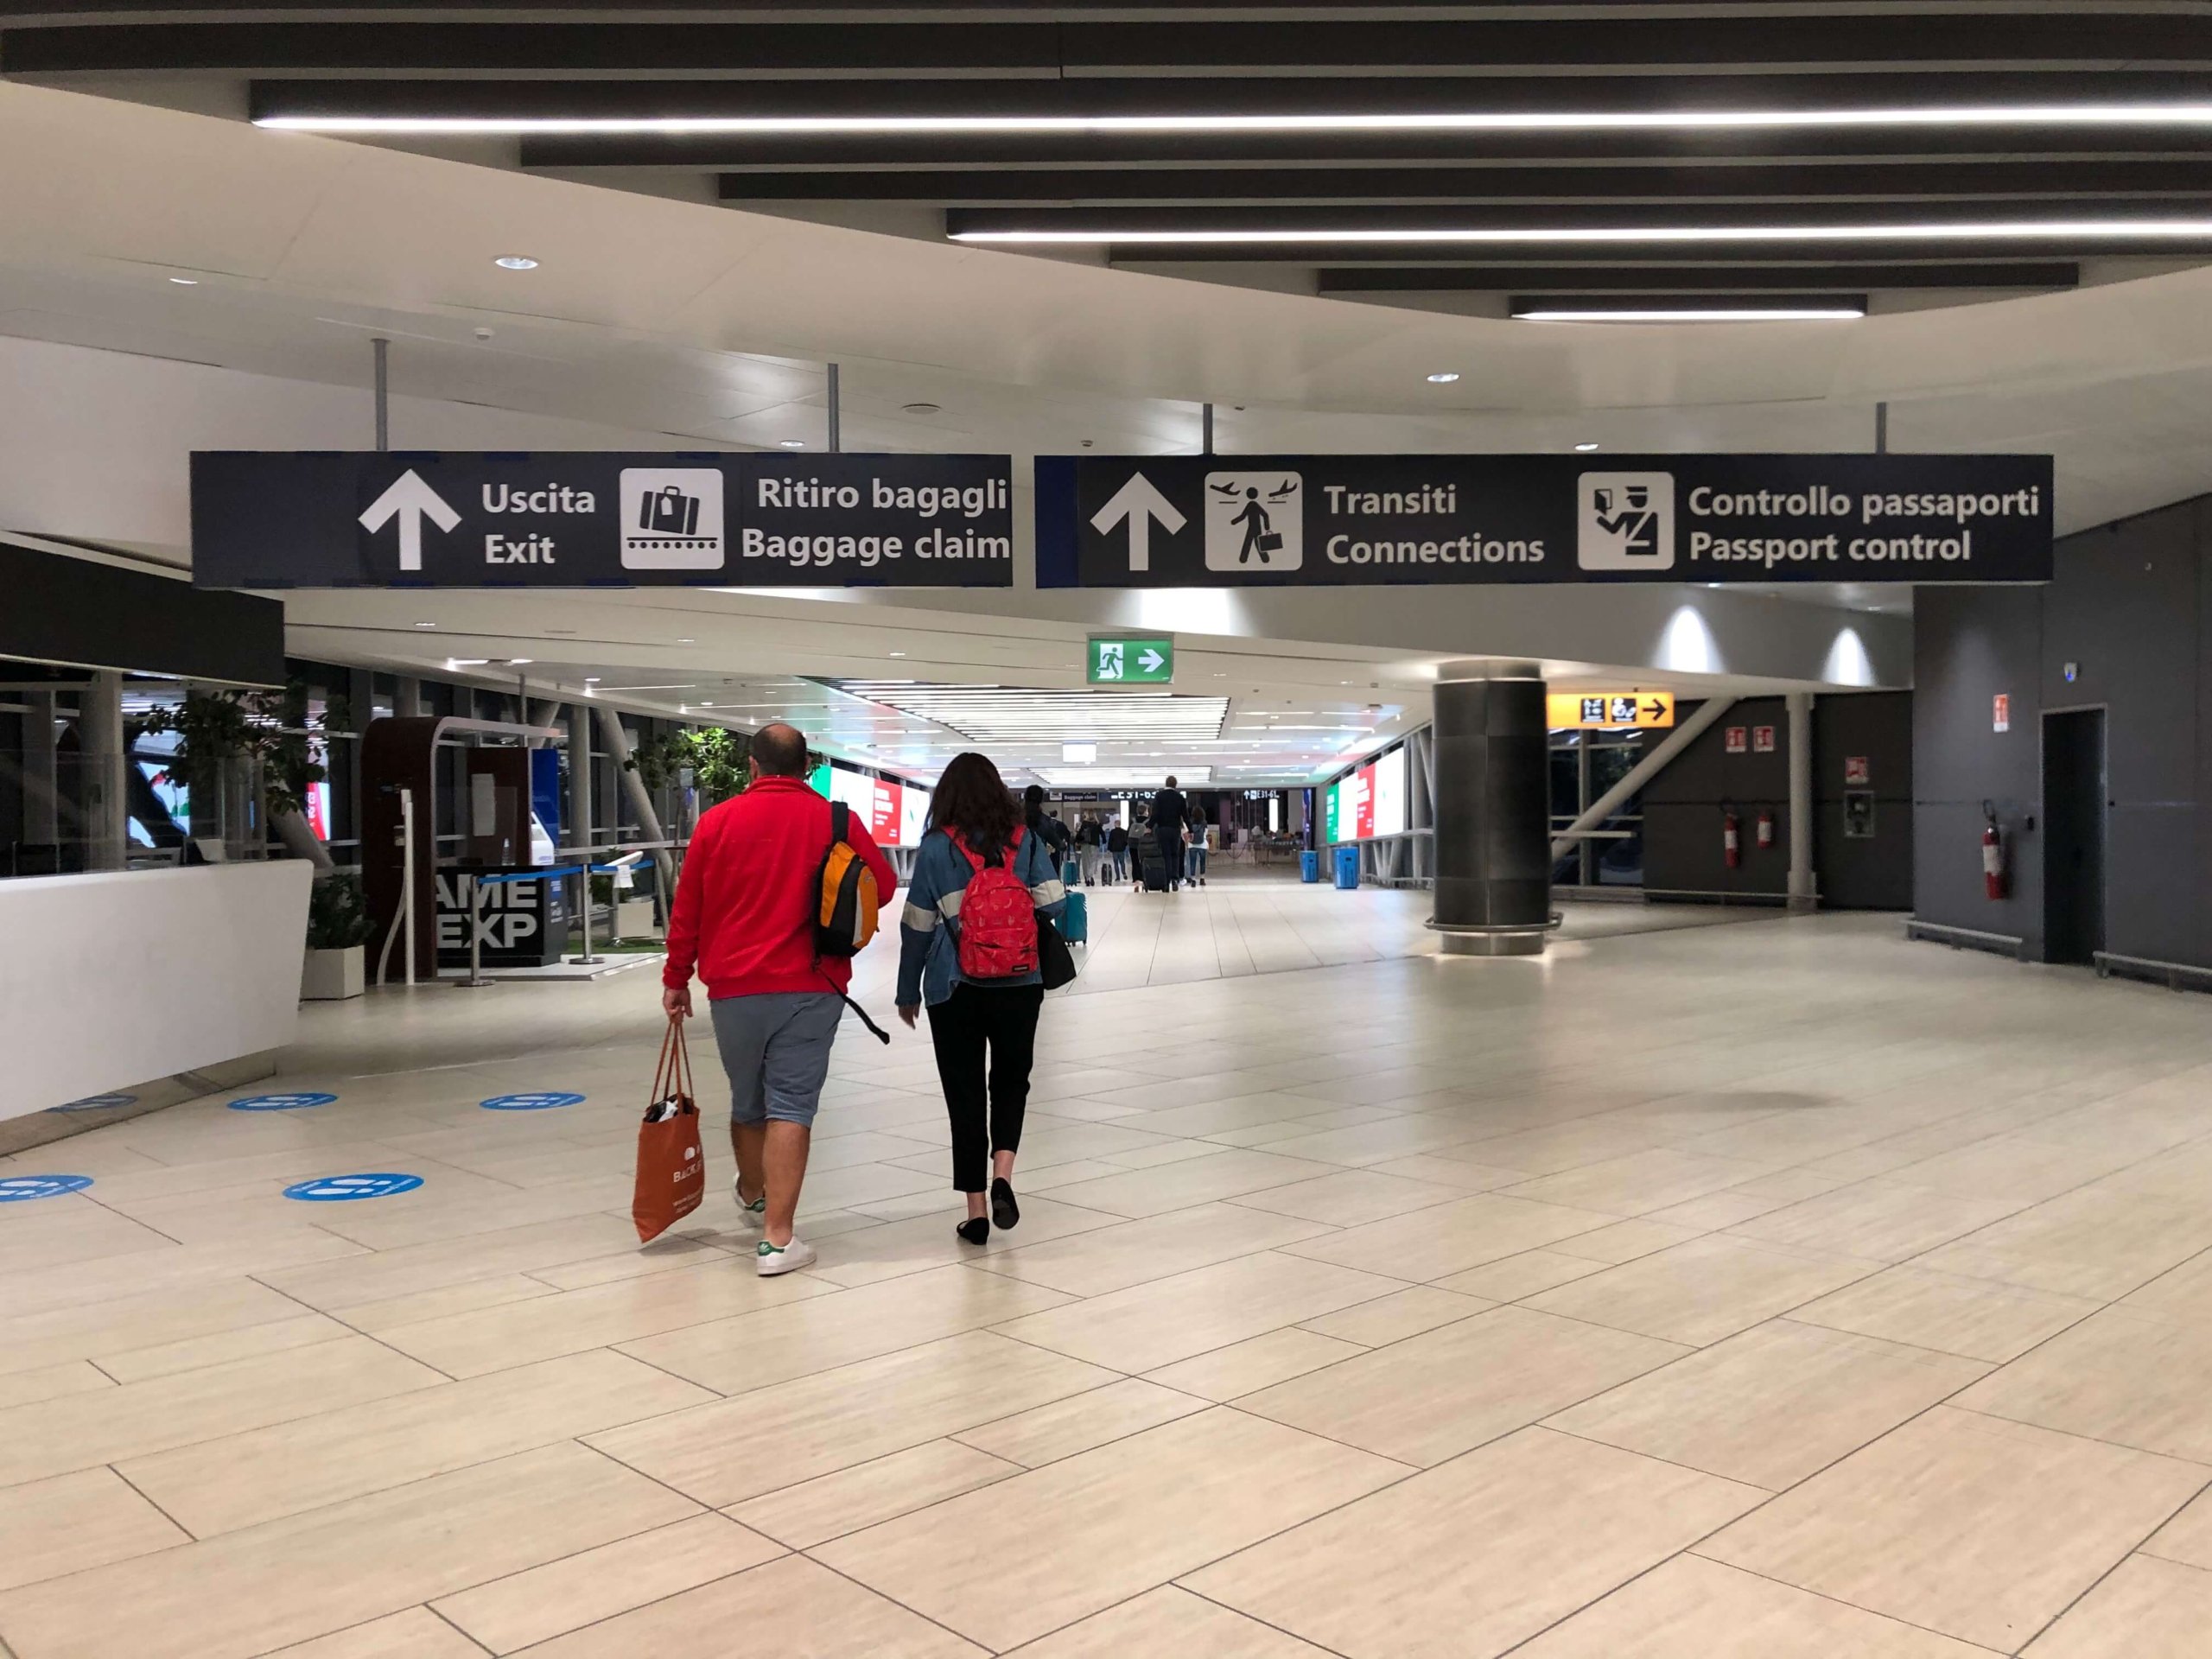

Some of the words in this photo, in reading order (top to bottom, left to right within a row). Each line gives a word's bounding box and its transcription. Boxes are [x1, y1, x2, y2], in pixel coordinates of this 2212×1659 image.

[482, 482, 596, 513] Uscita
[759, 477, 859, 508] Ritiro
[873, 478, 1007, 518] bagagli
[1324, 484, 1456, 514] Transiti
[1690, 486, 1850, 515] Controllo
[1863, 486, 2039, 524] passaporti
[485, 533, 555, 564] Exit
[741, 528, 904, 567] Baggage
[915, 528, 1011, 558] claim
[1326, 532, 1545, 563] Connections
[1691, 531, 1838, 569] Passport
[1848, 530, 1971, 560] control
[437, 913, 537, 949] EXP
